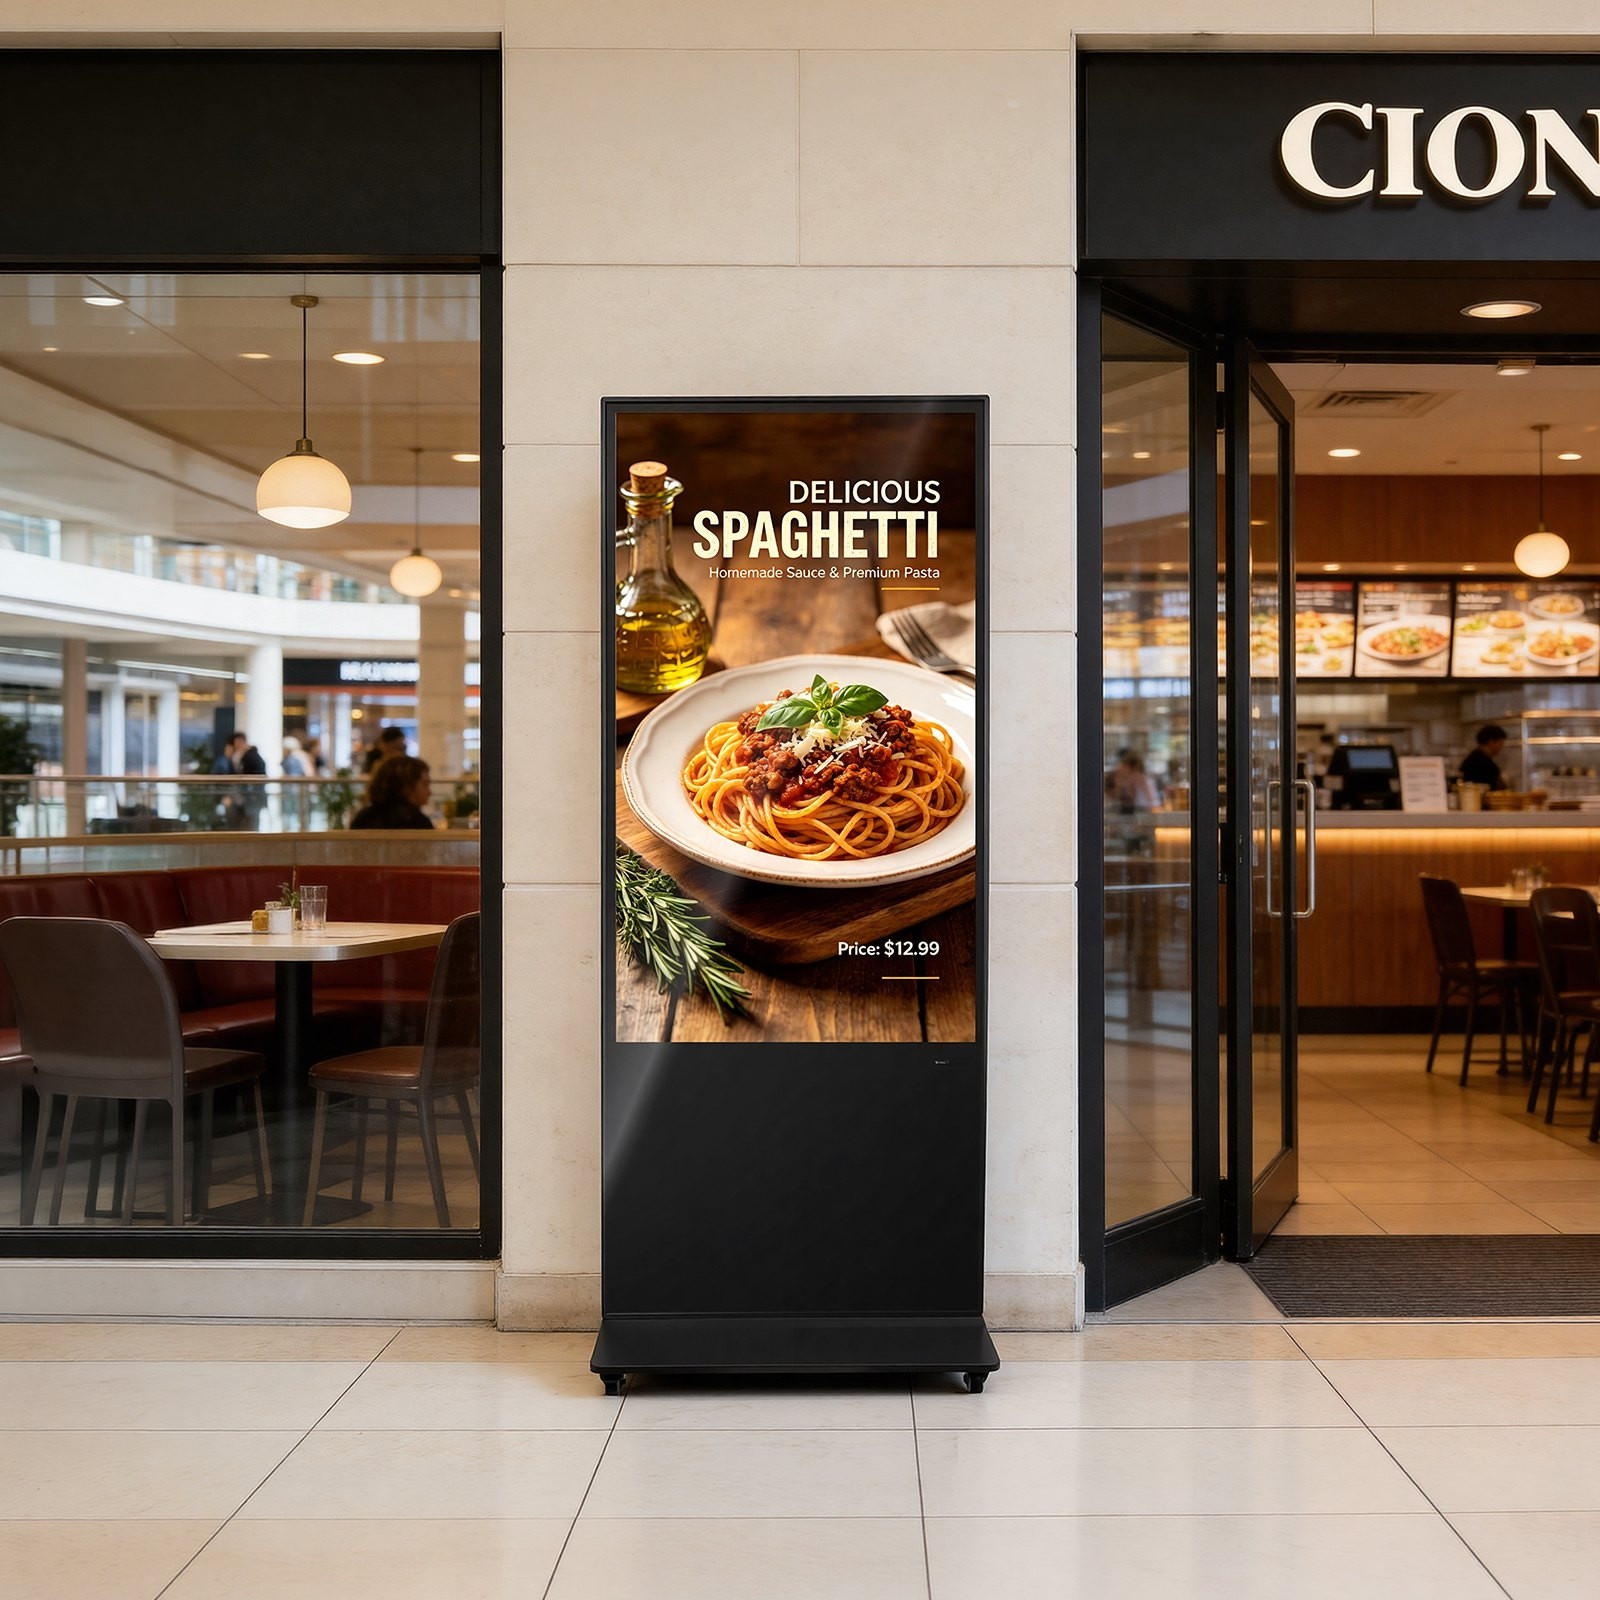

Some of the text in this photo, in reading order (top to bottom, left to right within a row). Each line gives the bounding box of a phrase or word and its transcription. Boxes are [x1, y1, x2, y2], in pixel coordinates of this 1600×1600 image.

[1281, 102, 1600, 198] CION
[789, 480, 941, 504] DELICIOUS
[693, 509, 938, 559] SPAGHETTI
[709, 566, 940, 579] Homemade Sauce & Premium Pasta
[838, 939, 940, 958] Price: $12.99
